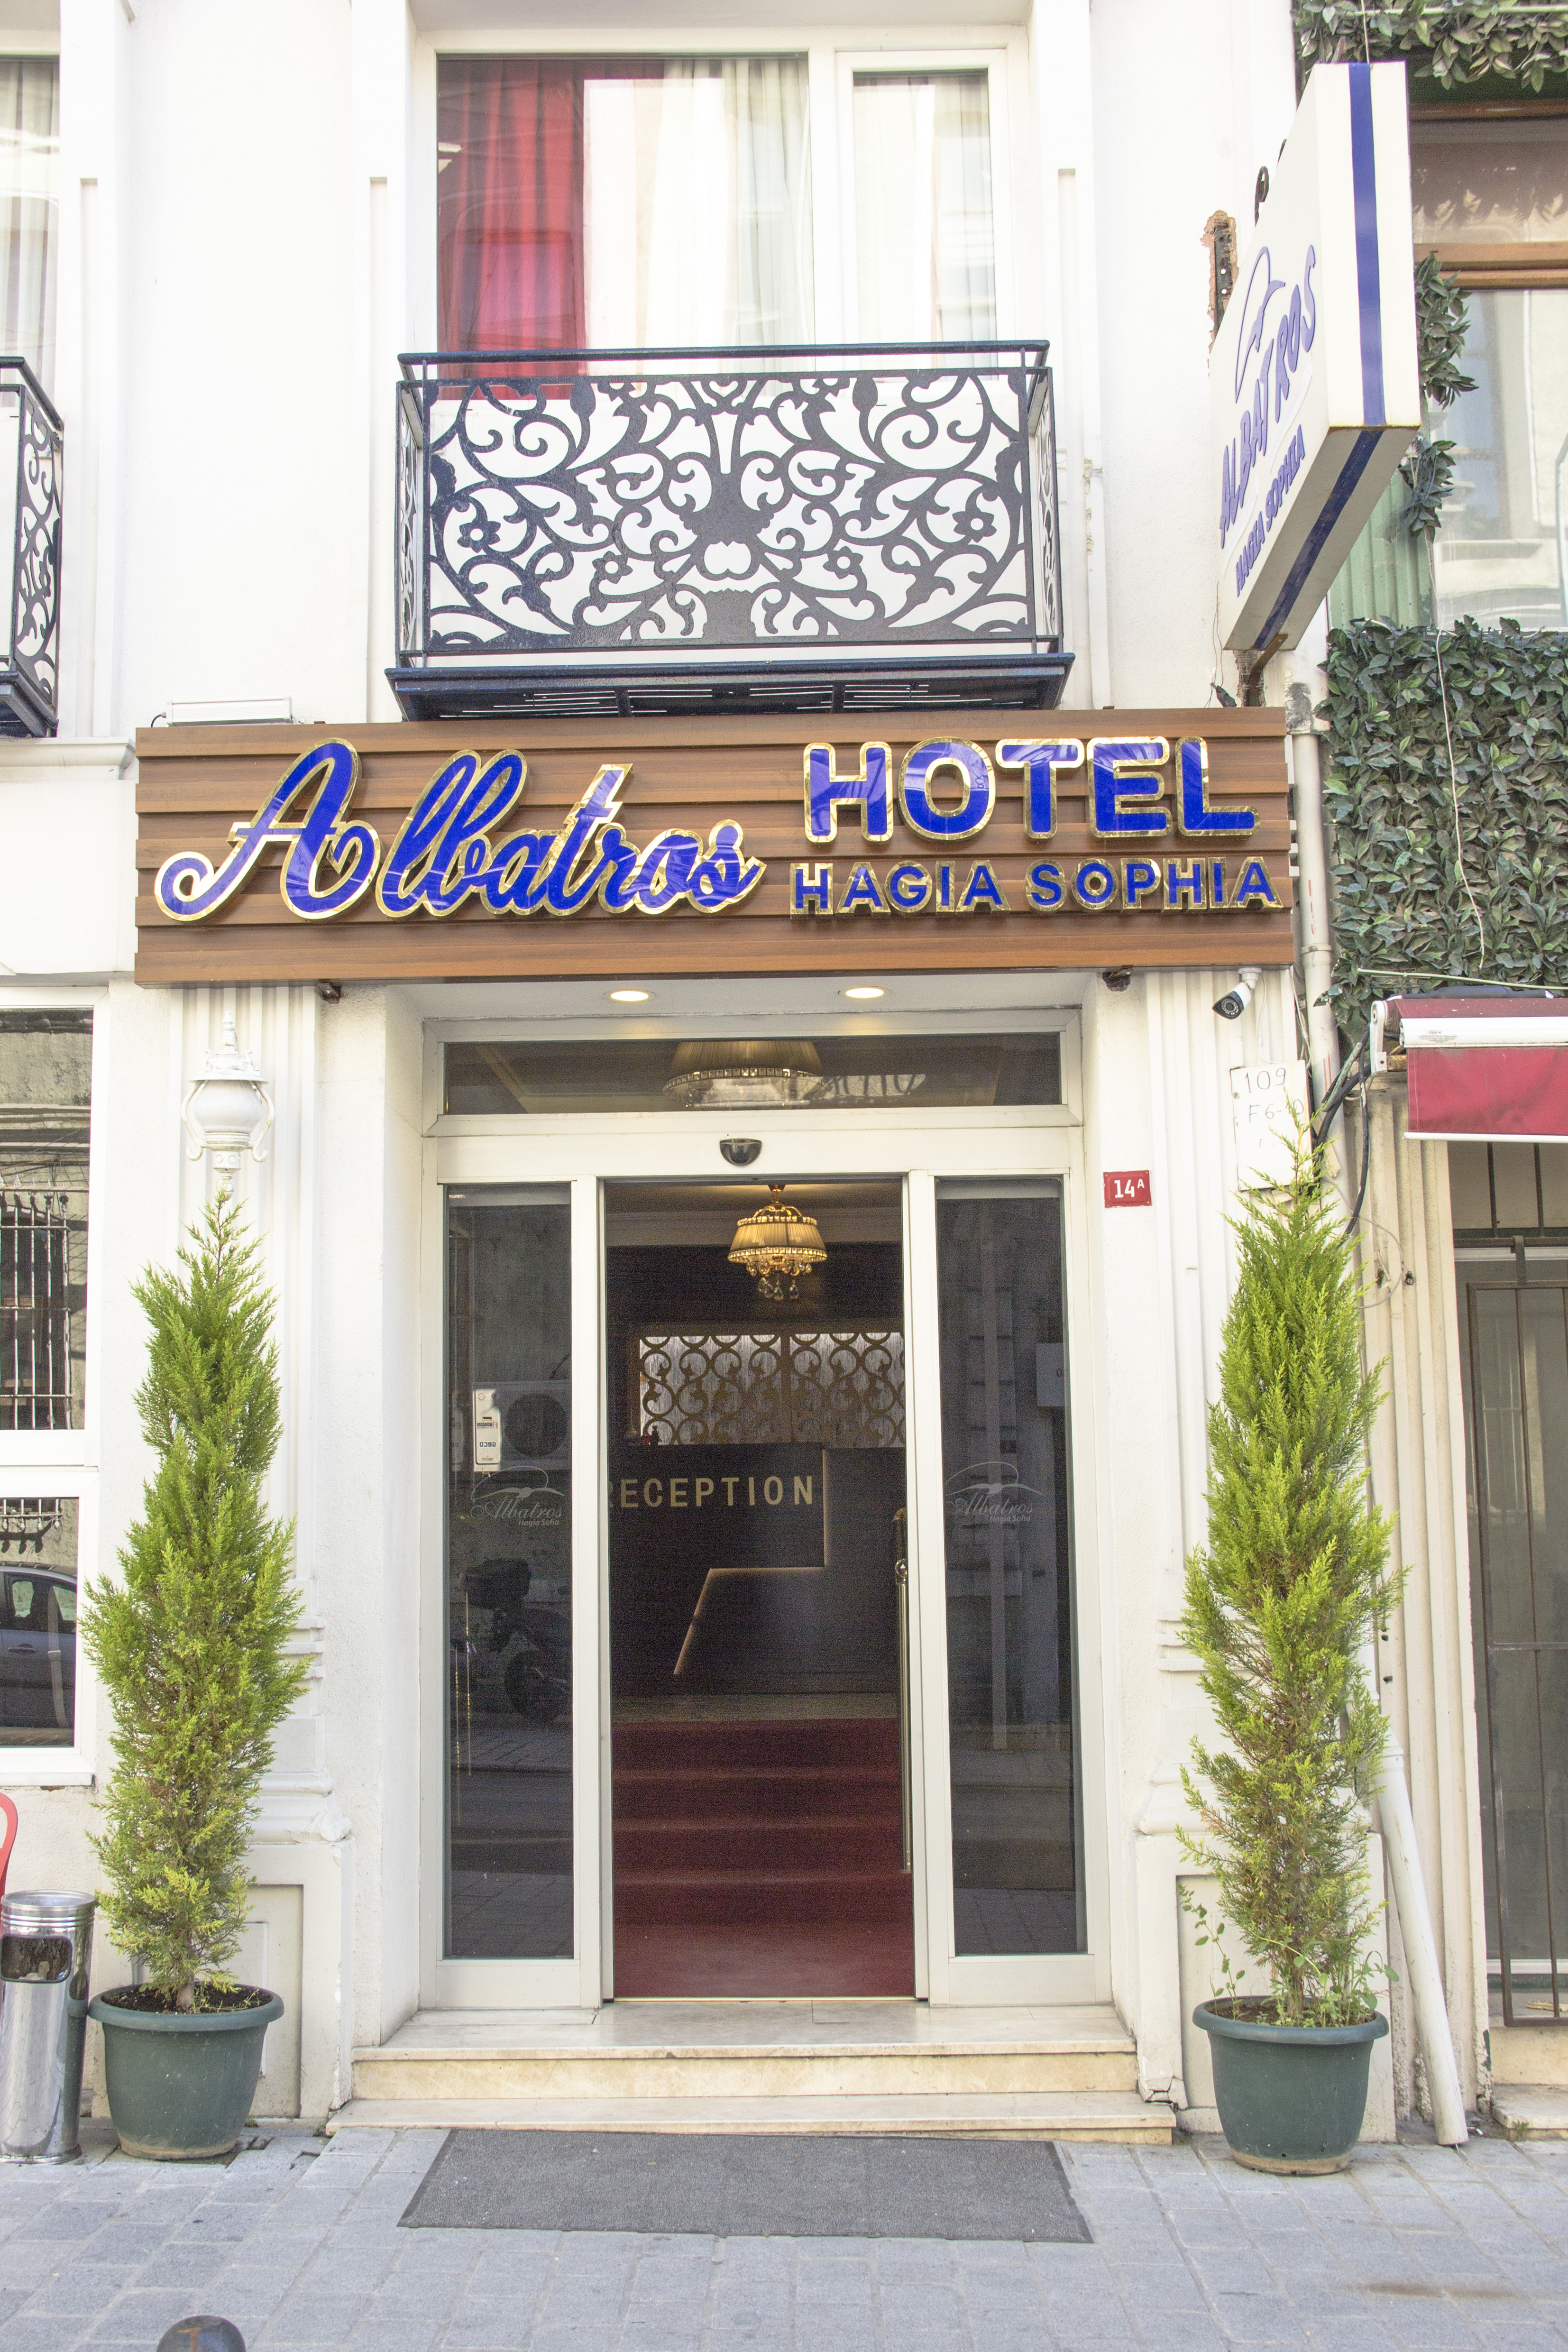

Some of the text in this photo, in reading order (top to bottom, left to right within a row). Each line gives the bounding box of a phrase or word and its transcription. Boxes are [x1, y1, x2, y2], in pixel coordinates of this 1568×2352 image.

[1220, 245, 1316, 549] ALBATROS
[1235, 424, 1305, 597] HAGIA SOPHIA
[155, 735, 1261, 921] Albatros HOTEL
[789, 856, 1284, 919] HAGIA SOPHIA
[1245, 1067, 1286, 1093] 109
[609, 1476, 813, 1508] ECEPTION
[945, 1492, 1033, 1516] Albatros
[470, 1495, 562, 1519] Albatros
[990, 1515, 1010, 1524] Hagia
[518, 1519, 540, 1527] Hagia
